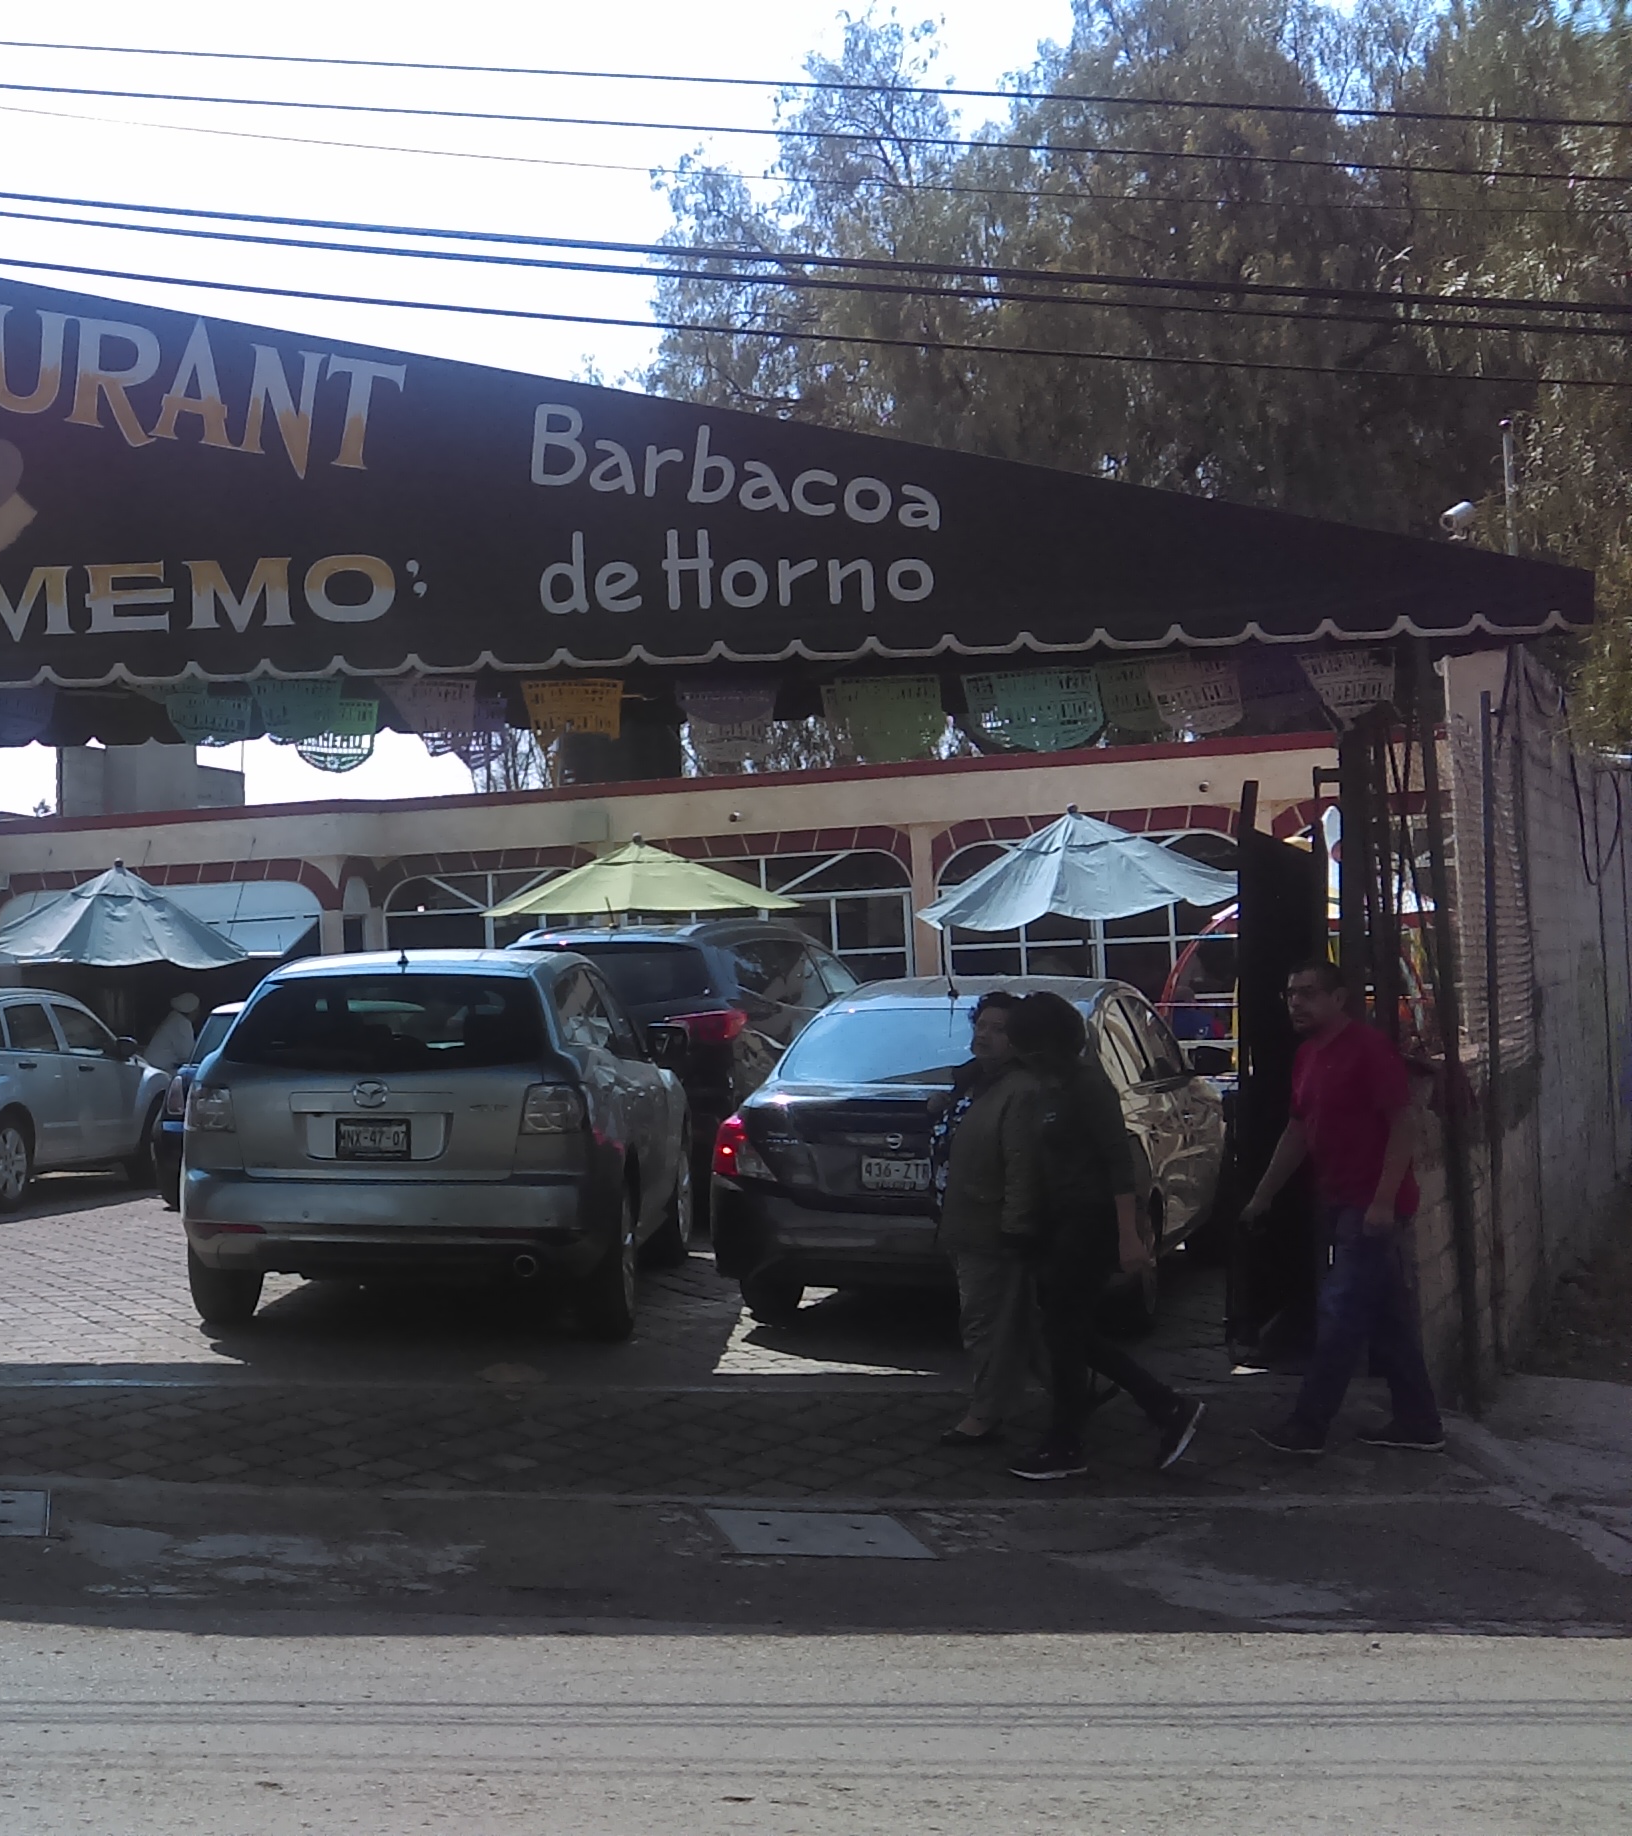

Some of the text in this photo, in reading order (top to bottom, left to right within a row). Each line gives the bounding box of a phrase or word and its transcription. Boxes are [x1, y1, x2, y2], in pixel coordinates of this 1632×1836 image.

[530, 403, 941, 531] Barbacoa
[540, 529, 935, 614] de Horno
